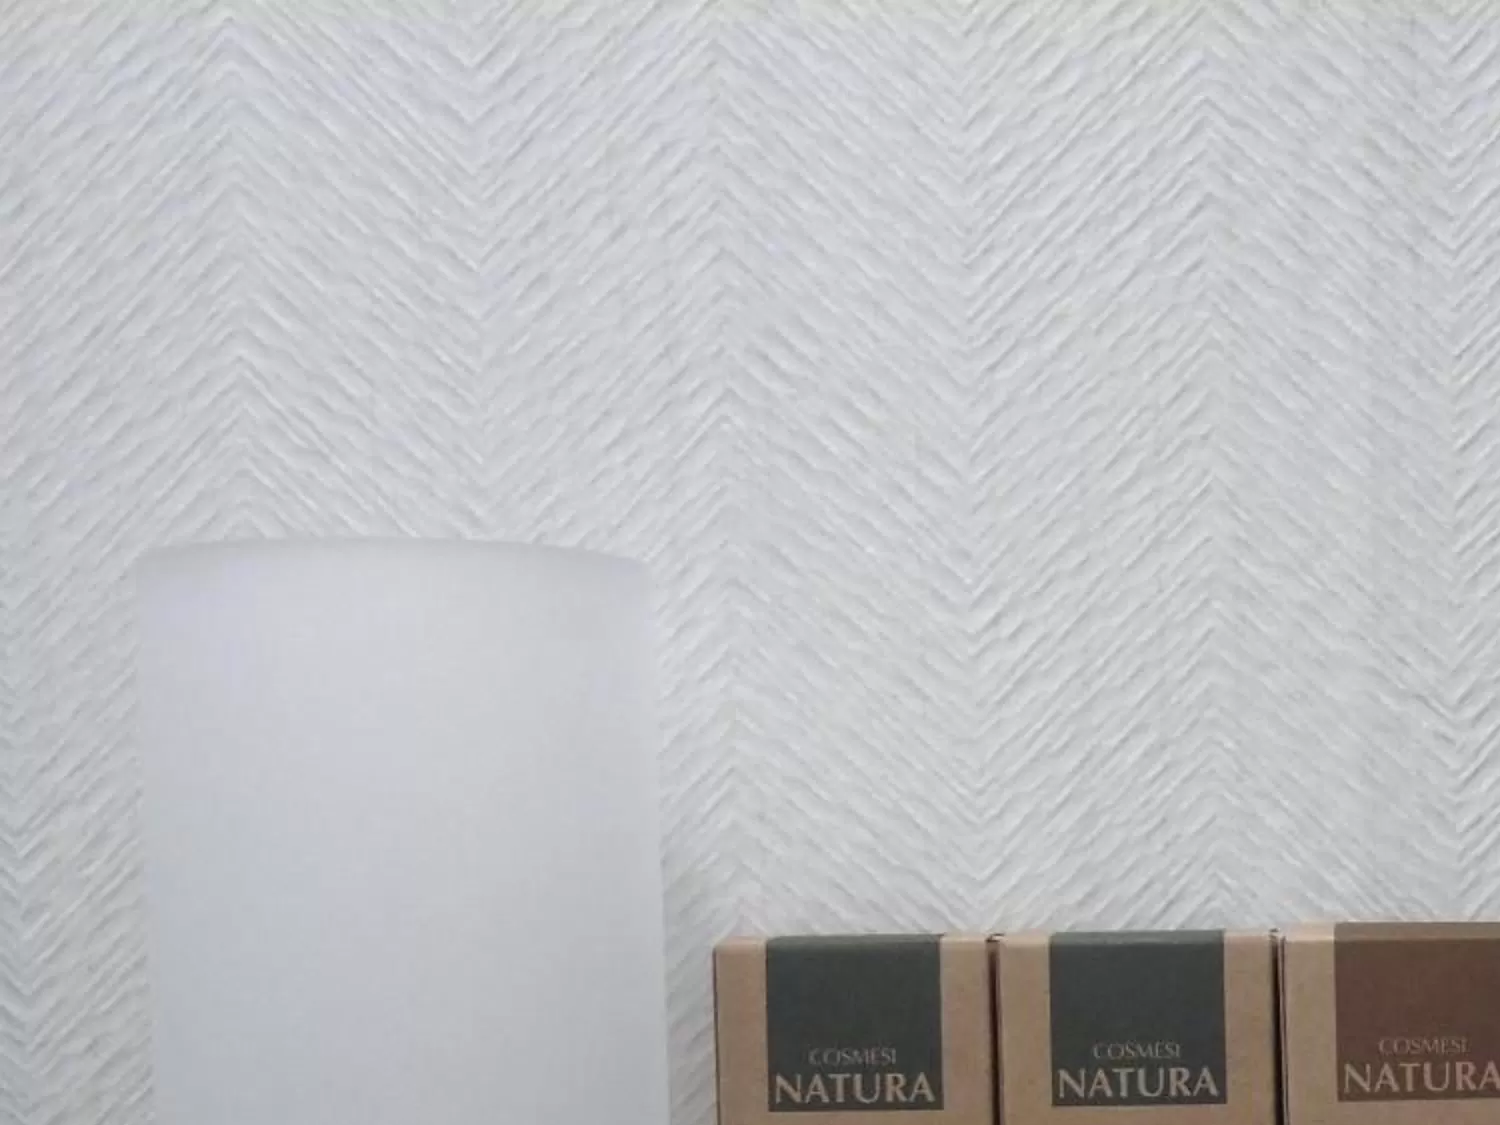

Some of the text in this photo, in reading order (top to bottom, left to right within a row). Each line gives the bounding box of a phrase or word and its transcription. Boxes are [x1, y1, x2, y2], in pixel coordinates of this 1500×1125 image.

[808, 1046, 898, 1067] COSMESI
[774, 1070, 937, 1105] NATURA
[1057, 1066, 1220, 1100] NATURA
